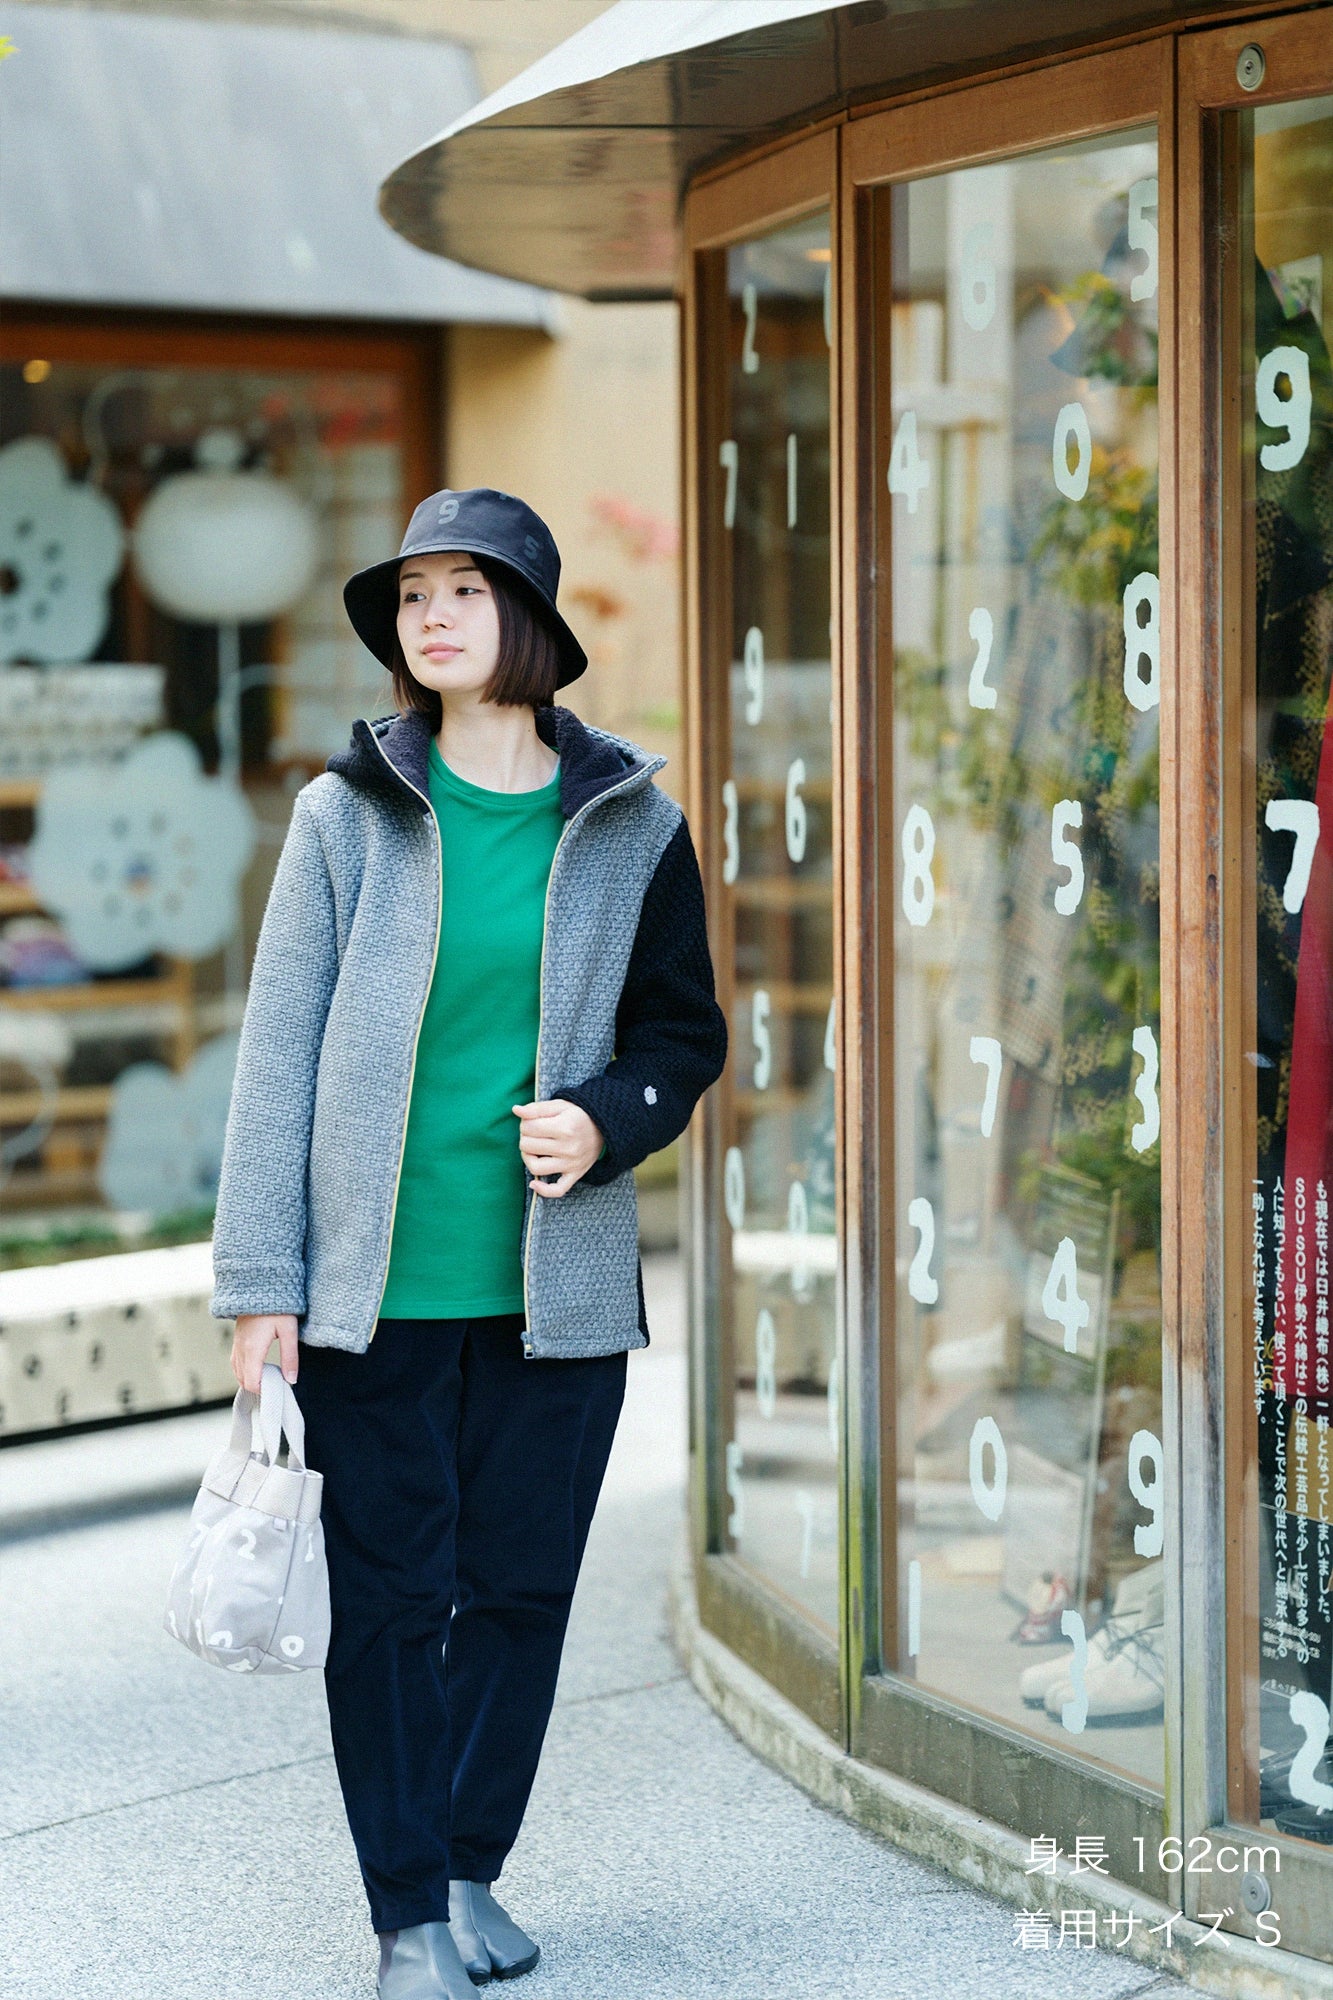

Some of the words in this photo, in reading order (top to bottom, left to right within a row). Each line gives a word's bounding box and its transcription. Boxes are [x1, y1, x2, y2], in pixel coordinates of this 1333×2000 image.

[960, 220, 996, 331] 6
[1128, 177, 1159, 303] 5
[887, 410, 931, 515] 4
[1053, 402, 1093, 501] 0
[1255, 345, 1313, 473] 9
[438, 499, 460, 525] 9
[744, 625, 764, 726] 9
[968, 607, 998, 710] 2
[1123, 571, 1160, 712] 8
[722, 779, 740, 886] 3
[785, 757, 807, 863] 6
[1051, 799, 1085, 916] 5
[1265, 799, 1320, 914] 7
[901, 804, 936, 926] 8
[752, 989, 771, 1091] 5
[969, 1036, 1002, 1138] 7
[1131, 1025, 1161, 1154] 3
[908, 1197, 938, 1305] 2
[1042, 1236, 1089, 1353] 4
[1252, 1178, 1267, 1426] 一助となればと考えています。
[969, 1416, 1009, 1522] 0
[1128, 1429, 1163, 1558] 9
[238, 1529, 257, 1561] 2
[908, 1560, 921, 1656] 1
[1289, 1690, 1333, 1811] 2
